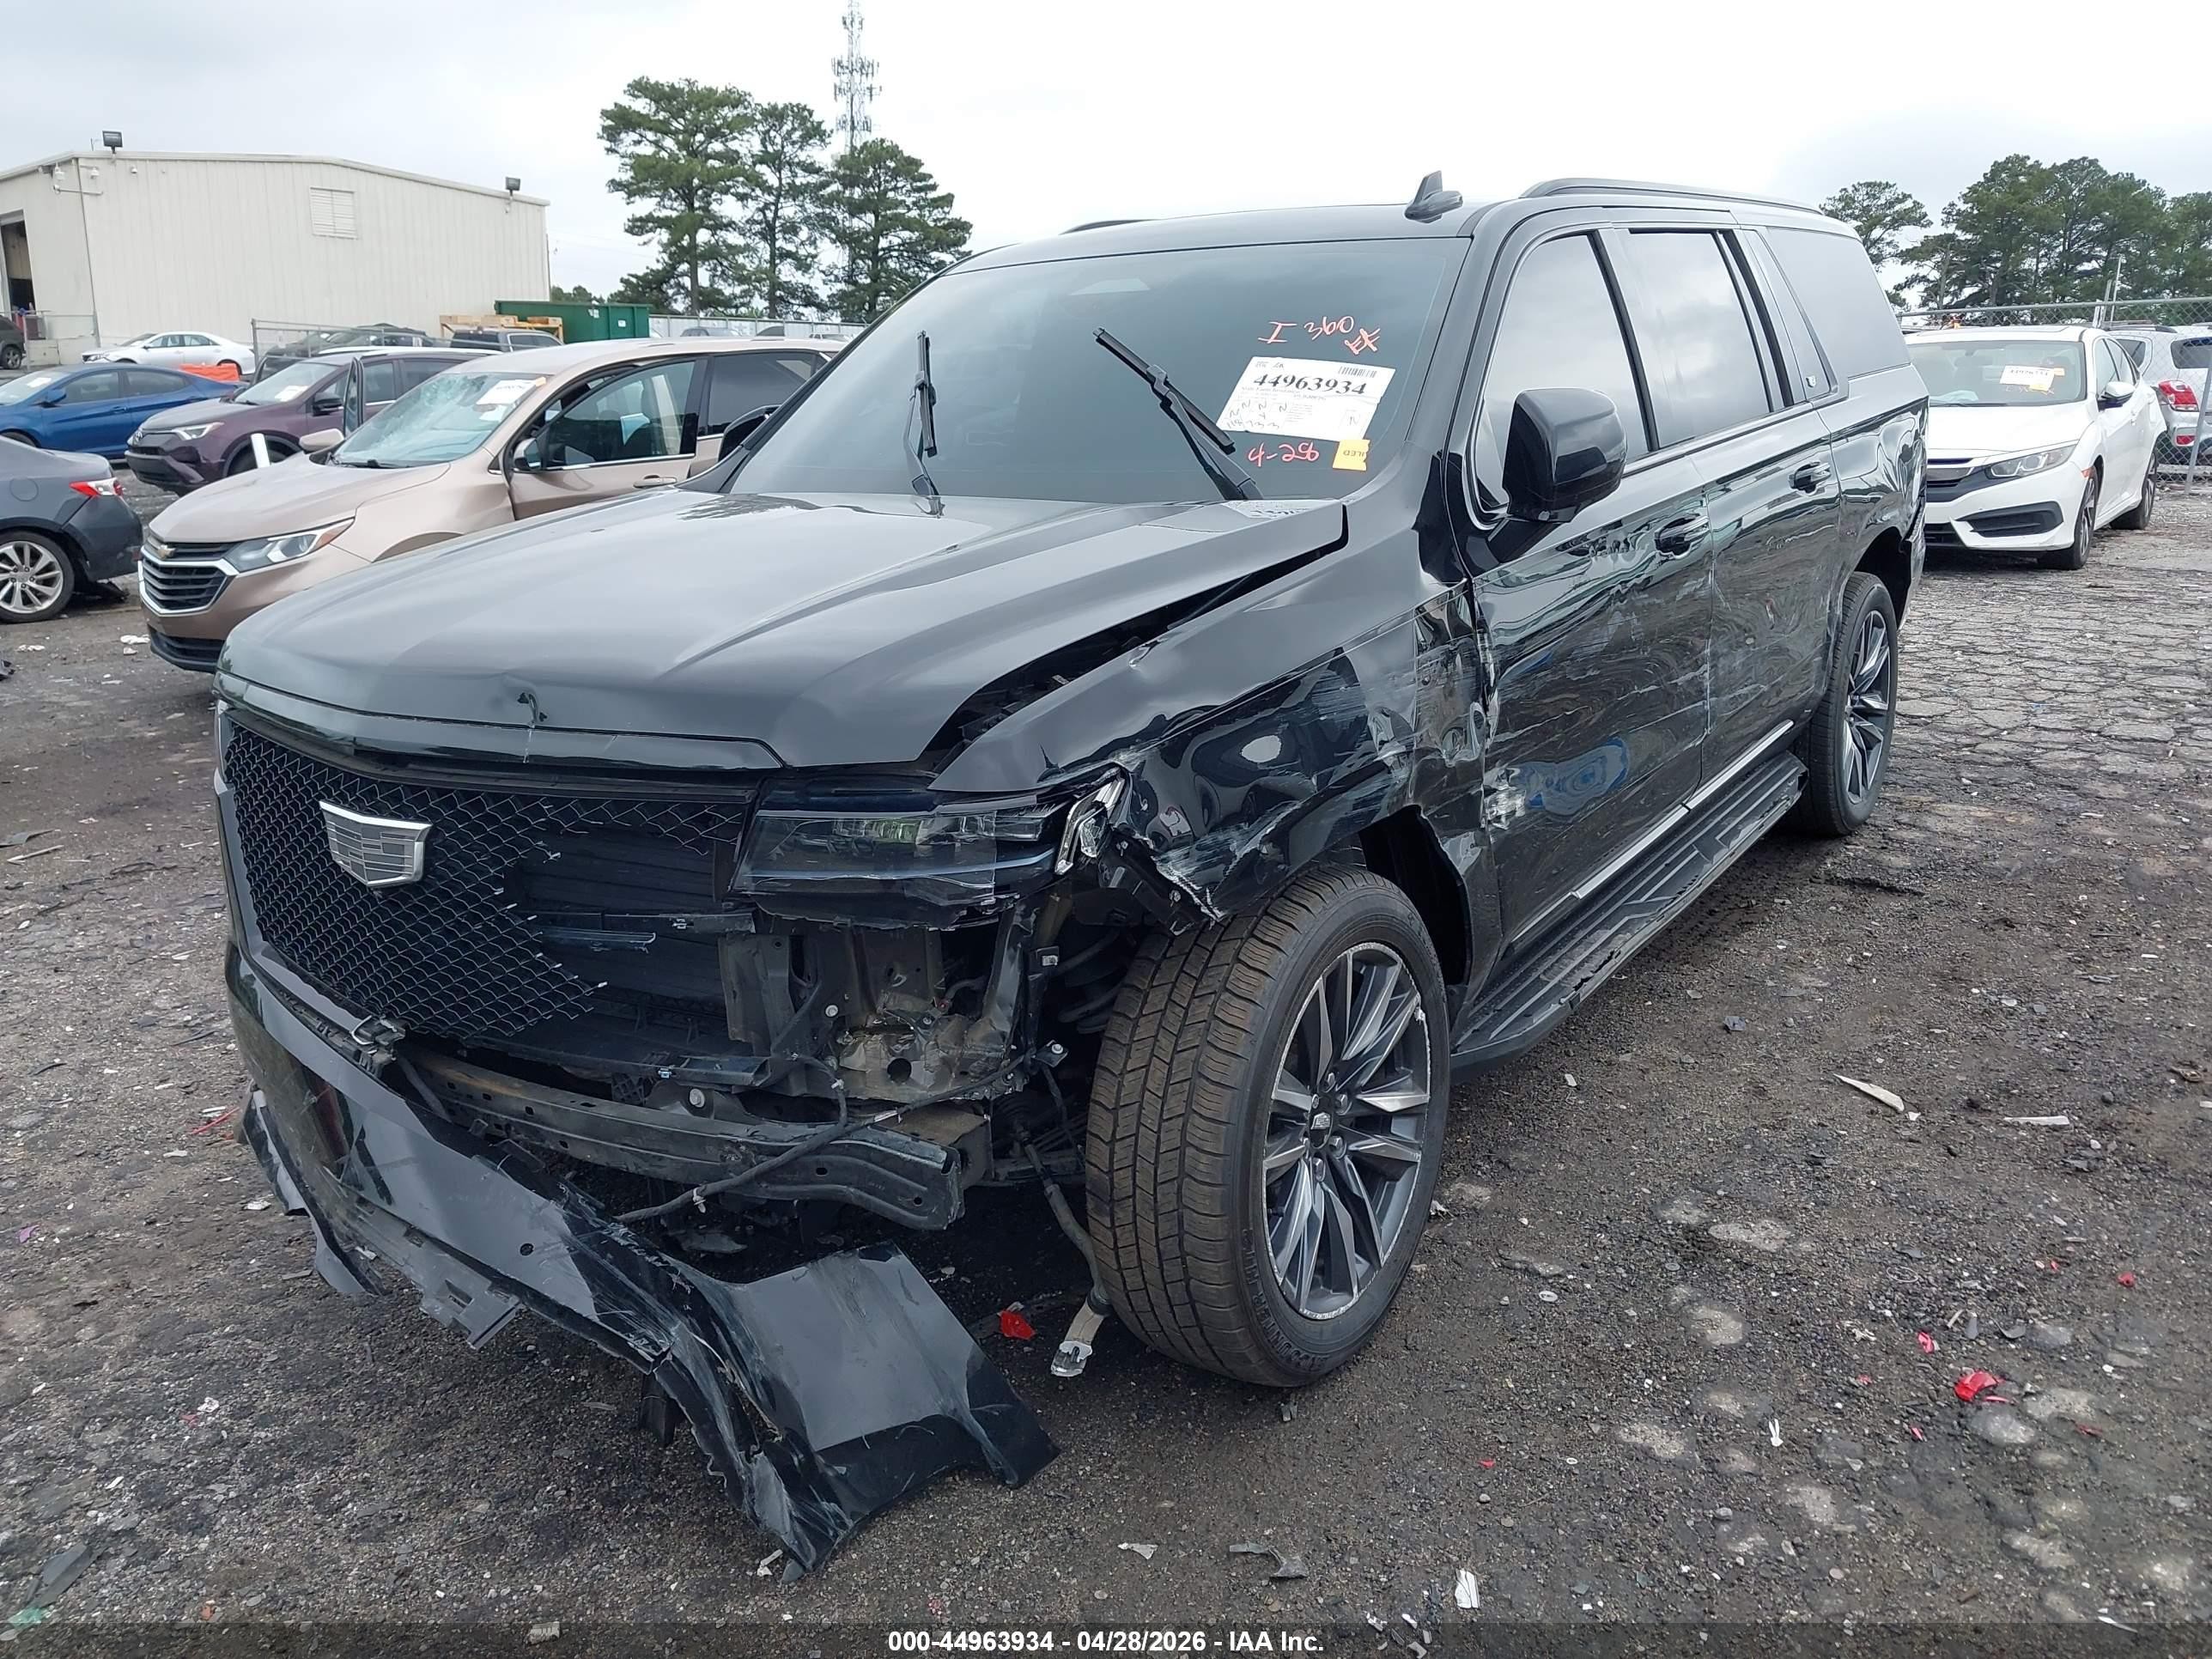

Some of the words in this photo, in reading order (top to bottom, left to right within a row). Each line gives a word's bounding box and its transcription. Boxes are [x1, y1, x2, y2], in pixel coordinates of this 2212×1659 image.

[1304, 315, 1355, 341] 360
[1253, 373, 1367, 395] 44963934
[1248, 441, 1320, 467] 4-28
